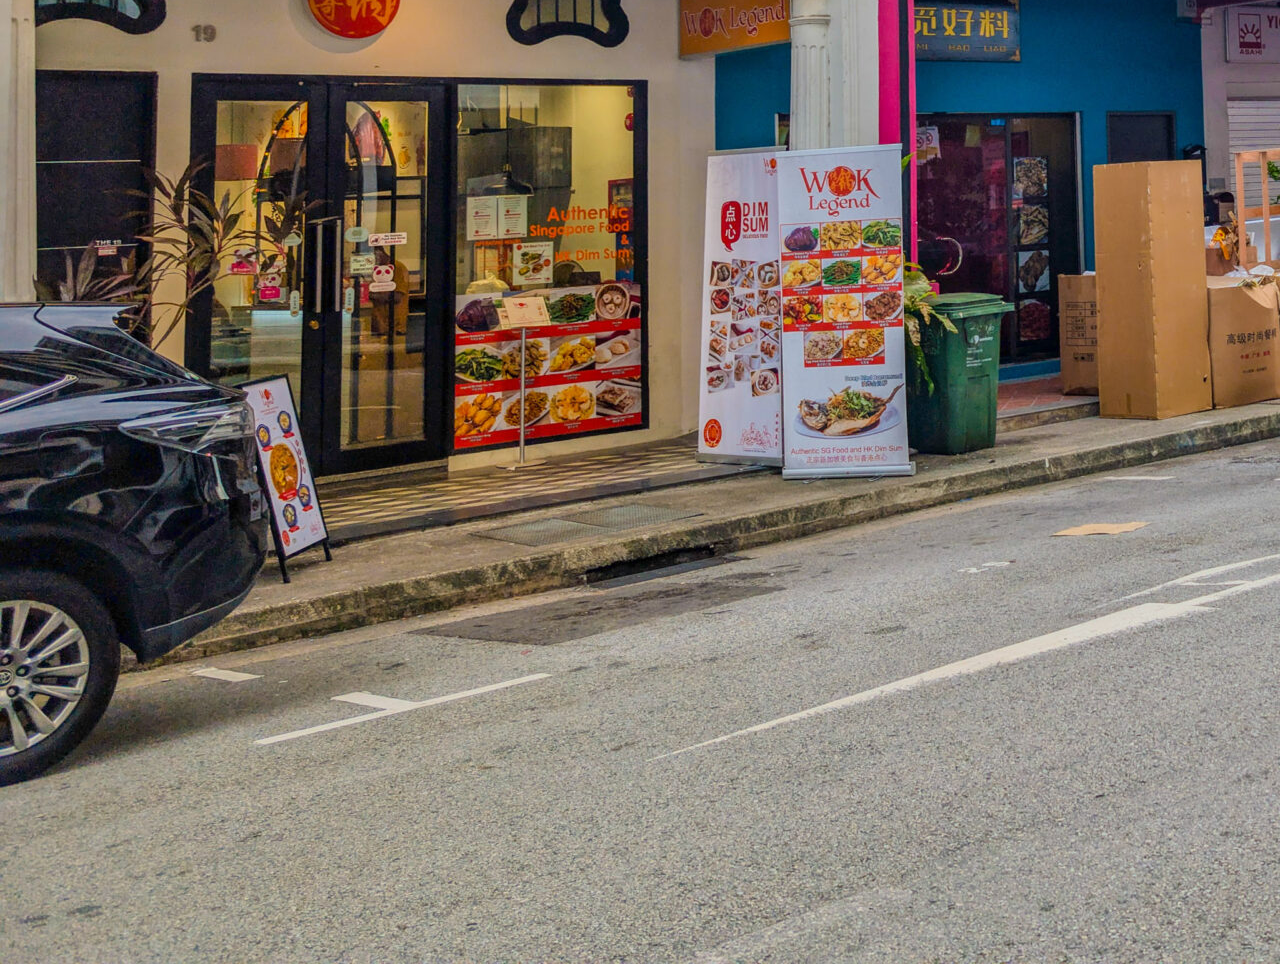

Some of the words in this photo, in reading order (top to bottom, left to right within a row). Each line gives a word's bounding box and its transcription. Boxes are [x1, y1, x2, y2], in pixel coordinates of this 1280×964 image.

[191, 24, 217, 43] 19
[547, 204, 629, 222] Authentic
[742, 201, 768, 217] DIM
[808, 193, 871, 217] Legend
[529, 223, 595, 239] Singapore
[599, 220, 629, 233] Food
[725, 205, 736, 240] 点心
[742, 217, 768, 232] SUM
[621, 234, 628, 245] &
[576, 249, 600, 261] Dim
[604, 248, 630, 259] Sum
